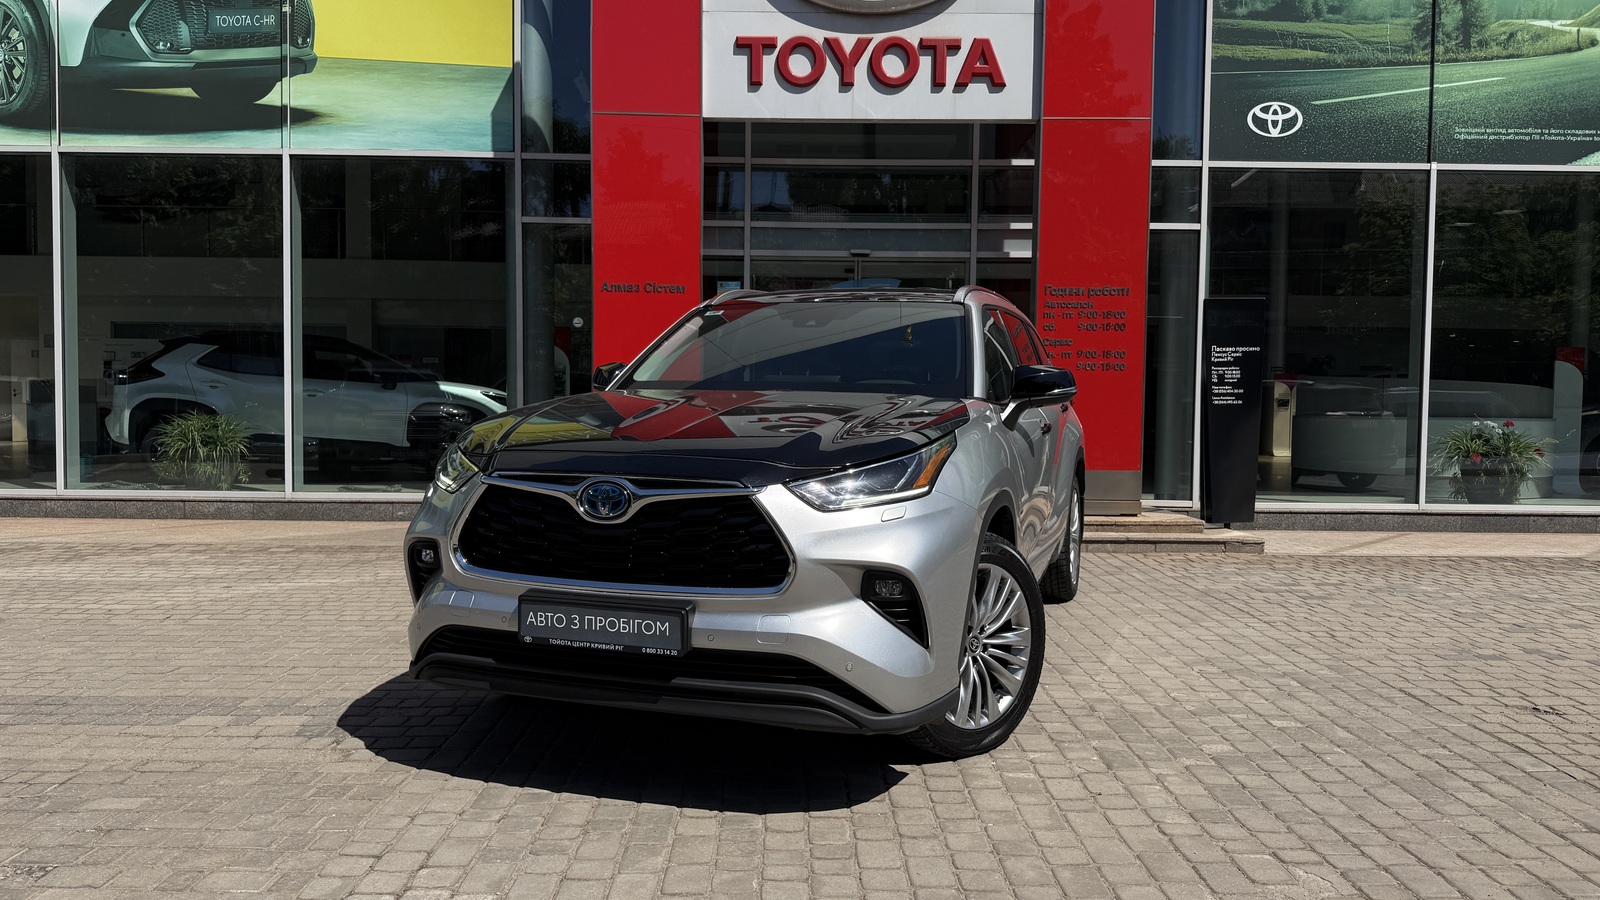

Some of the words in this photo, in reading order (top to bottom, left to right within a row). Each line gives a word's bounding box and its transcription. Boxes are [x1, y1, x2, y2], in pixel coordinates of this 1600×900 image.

[215, 15, 252, 27] TOYOTA
[253, 14, 276, 26] C-HR
[735, 35, 1007, 89] TOYOTA
[601, 281, 641, 293] Алмаз
[644, 282, 686, 294] Сістем
[1044, 285, 1086, 298] Години
[1087, 285, 1130, 299] роботи
[1043, 300, 1095, 309] Автосалон
[1043, 337, 1073, 348] Сервіс
[526, 611, 567, 628] АВТО
[570, 614, 580, 629] З
[584, 615, 670, 636] ПРОБІГОМ
[549, 638, 572, 647] ТОЙОТА
[572, 640, 591, 649] ЦЕНТР
[590, 642, 615, 651] КРИВИЙ
